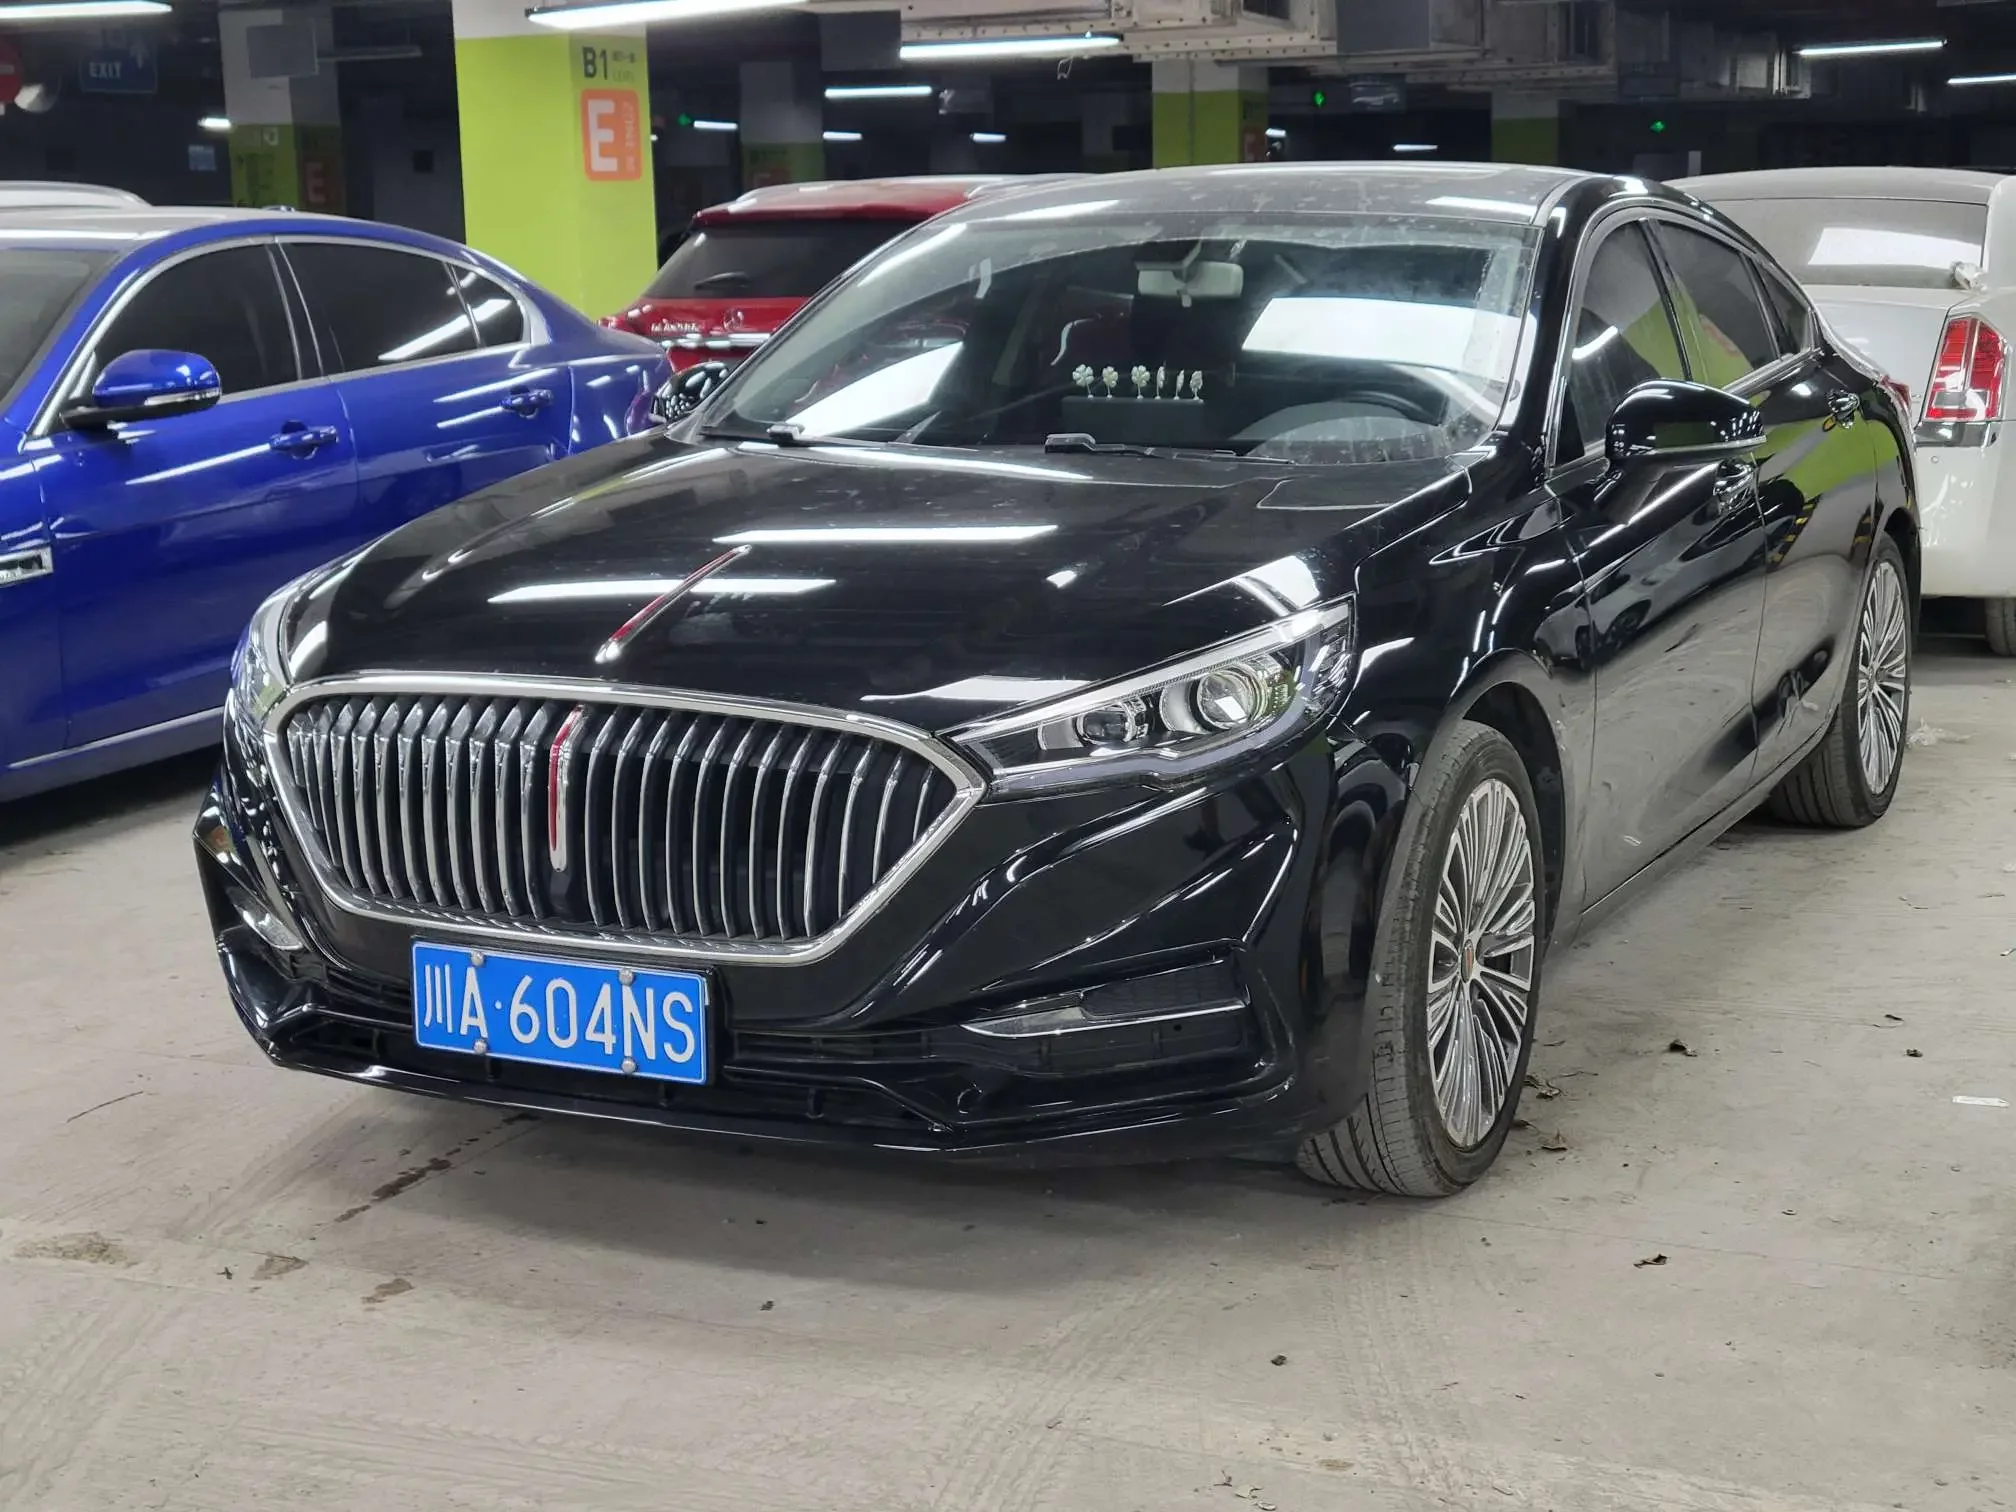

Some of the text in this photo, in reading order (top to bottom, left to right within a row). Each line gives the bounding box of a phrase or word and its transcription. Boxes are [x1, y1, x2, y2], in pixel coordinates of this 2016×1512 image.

[89, 61, 121, 78] EXIT
[582, 46, 608, 80] B1
[588, 99, 618, 172] E
[424, 963, 695, 1064] 川A·604NS
